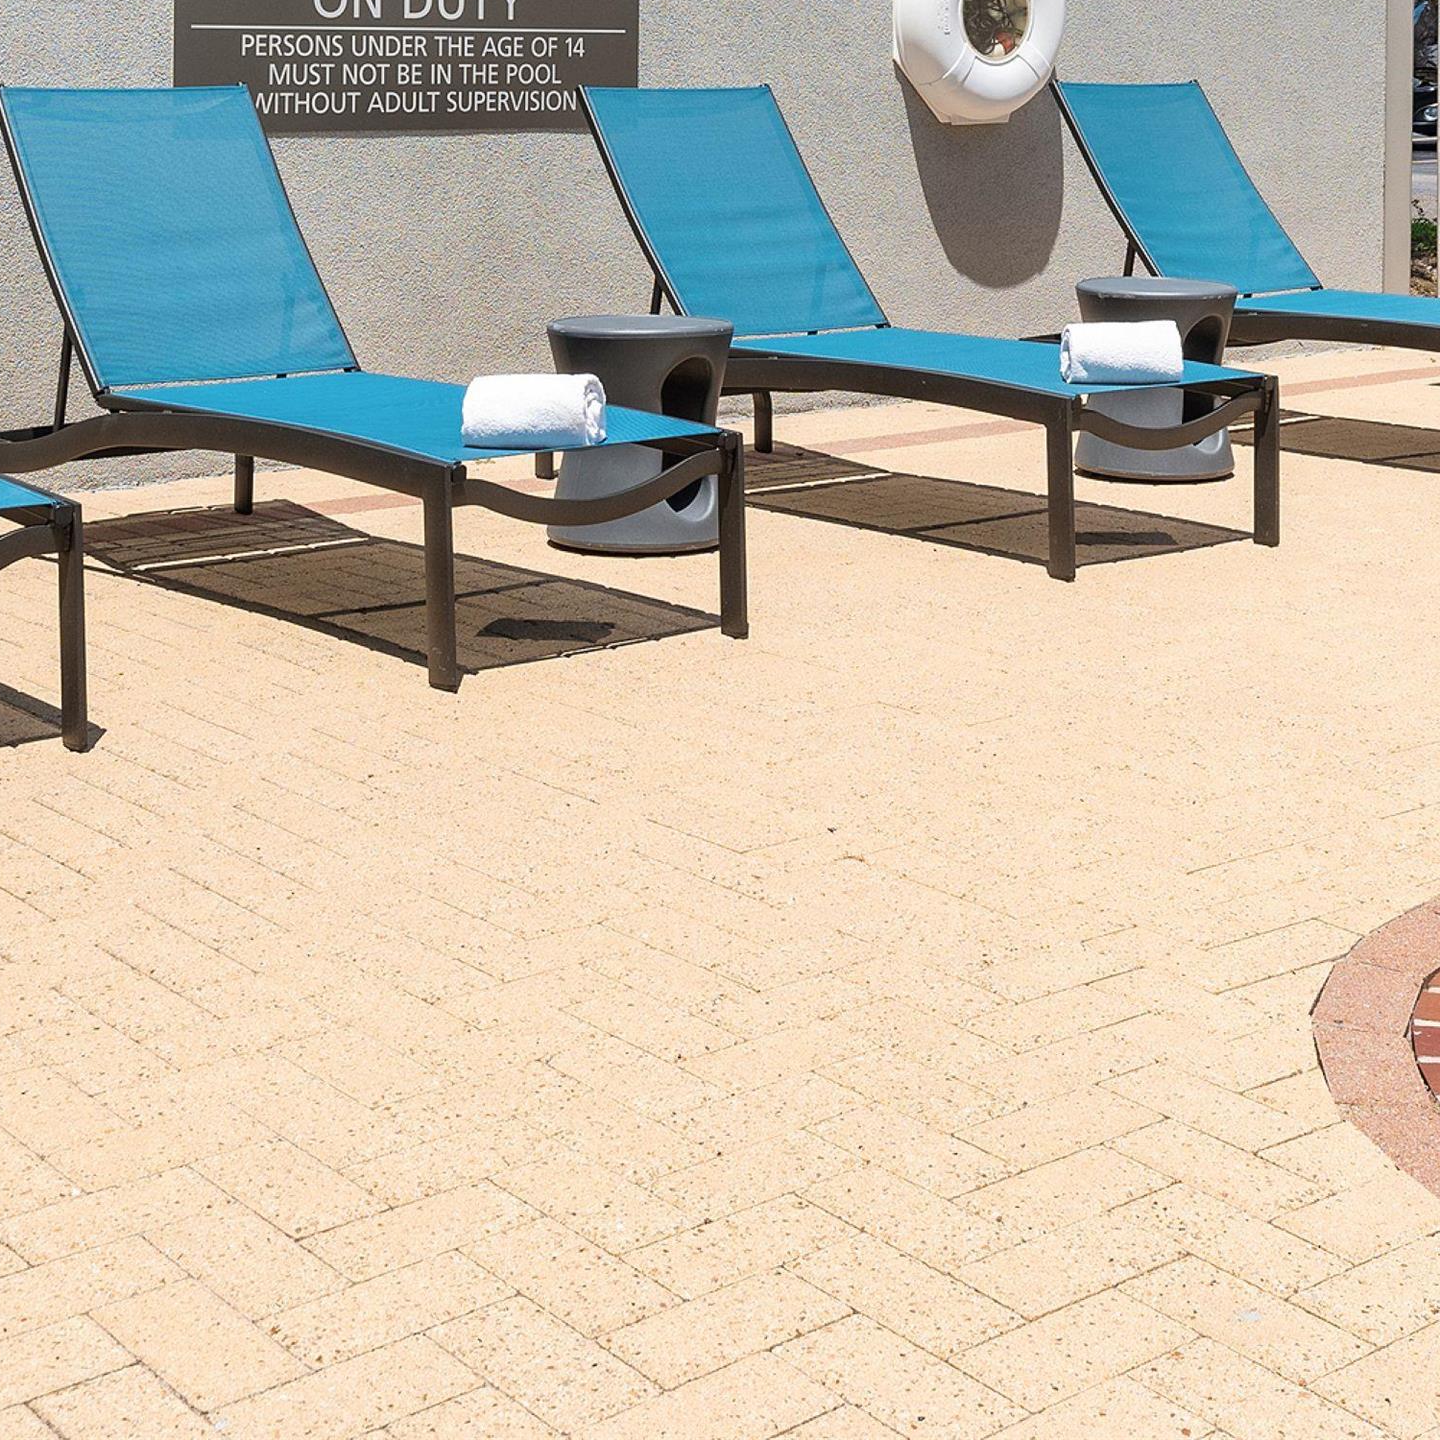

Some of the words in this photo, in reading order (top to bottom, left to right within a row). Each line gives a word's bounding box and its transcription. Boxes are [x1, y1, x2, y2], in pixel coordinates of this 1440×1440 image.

[241, 34, 343, 58] PERSONS
[352, 35, 427, 58] UNDER
[435, 36, 474, 57] THE
[482, 36, 524, 58] AGE
[531, 37, 558, 58] OF
[564, 37, 585, 58] 14
[269, 63, 335, 86] MUST
[342, 63, 390, 85] NOT
[398, 64, 423, 85] BE
[431, 64, 451, 85] IN
[458, 64, 498, 85] THE
[507, 63, 562, 85] POOL
[255, 92, 361, 115] WITHOUT
[367, 91, 440, 113] ADULT
[447, 90, 578, 112] SUPERVISION
